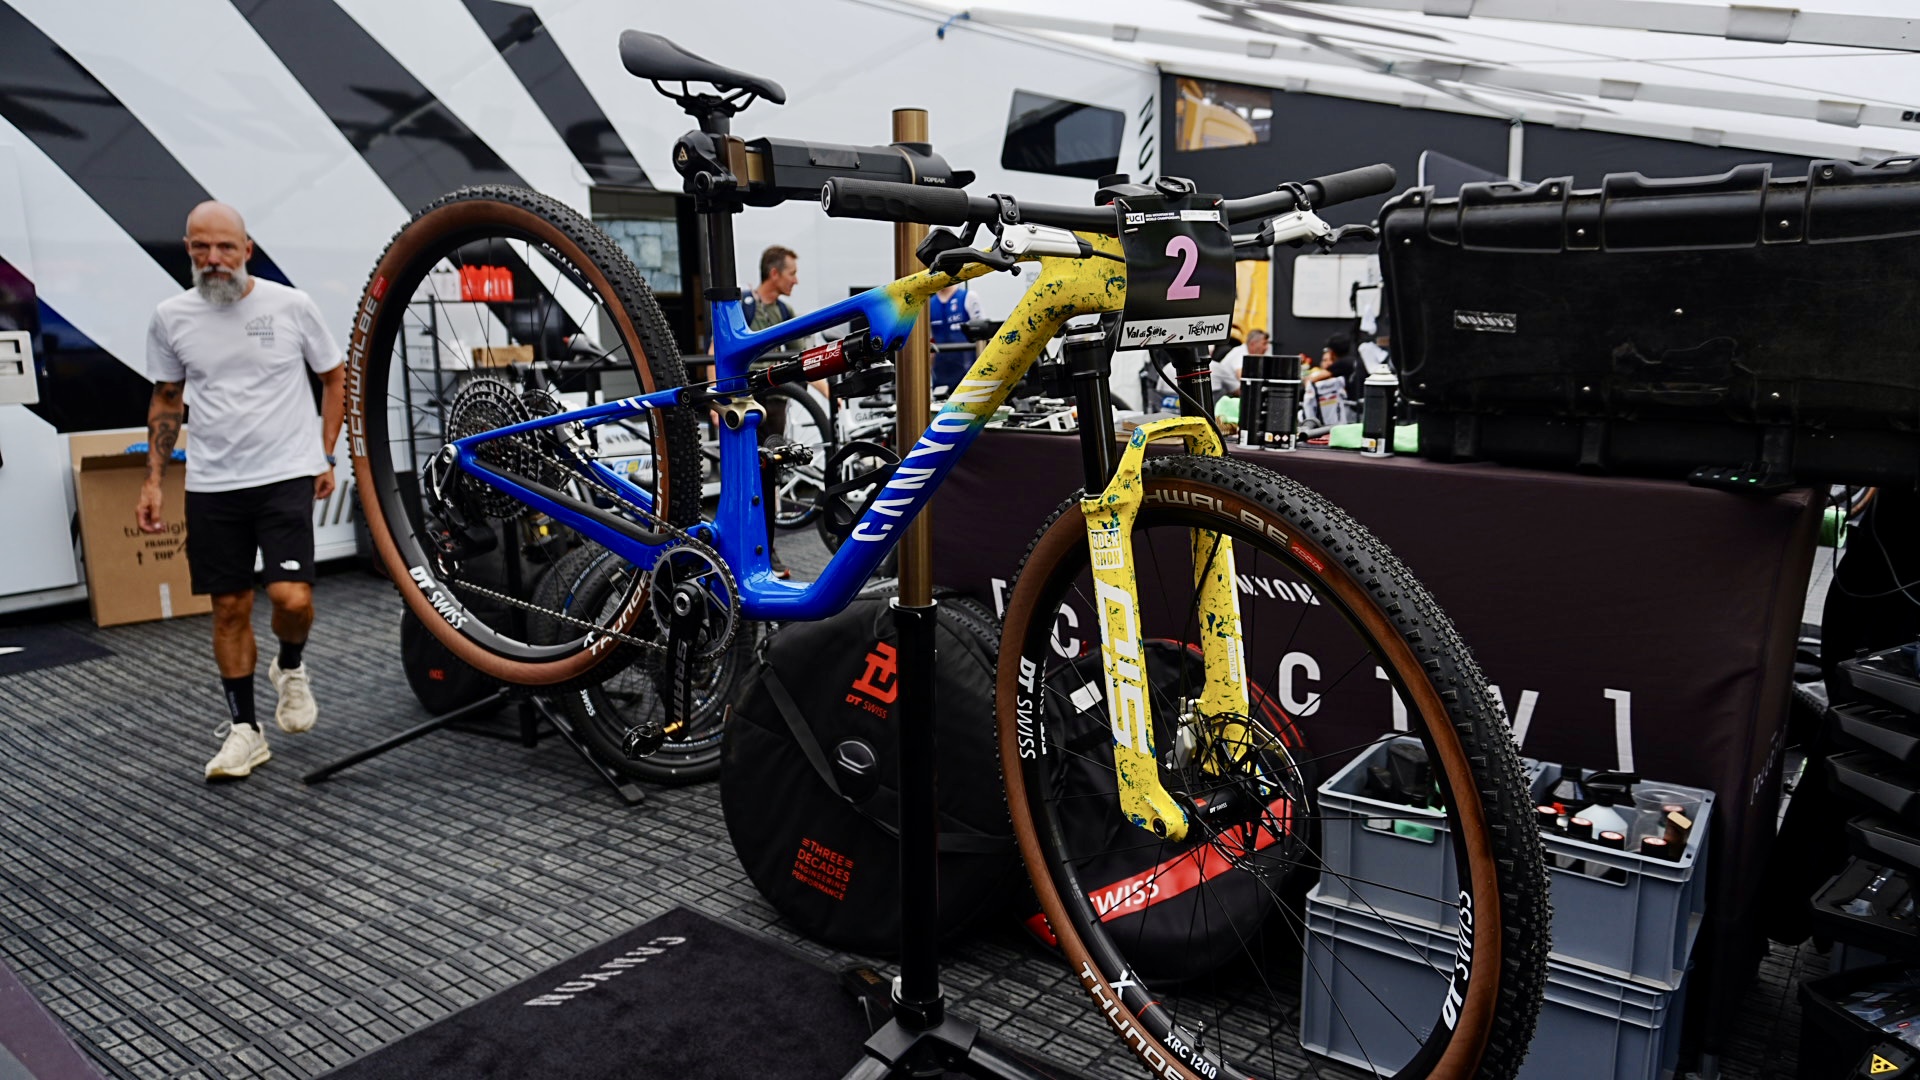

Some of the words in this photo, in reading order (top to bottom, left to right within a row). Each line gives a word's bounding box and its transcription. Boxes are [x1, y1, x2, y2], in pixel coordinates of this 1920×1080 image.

[922, 176, 946, 184] TOPEAK
[1129, 214, 1144, 223] UCI
[1165, 235, 1201, 301] 2
[1126, 326, 1140, 339] Val
[1187, 321, 1225, 336] TRENTINO
[350, 295, 379, 458] SCHWALBE
[851, 379, 1004, 542] CANYON
[1143, 488, 1289, 548] HWALBE
[153, 550, 174, 561] TOP
[1090, 530, 1120, 549] ROCK
[1094, 550, 1121, 567] SHOX
[408, 565, 437, 589] DT
[427, 590, 469, 630] SWISS
[1235, 573, 1321, 606] NYON
[589, 569, 650, 657] THUNDE
[673, 639, 688, 724] SRAM
[1018, 655, 1036, 694] DT
[579, 688, 597, 717] SWISS
[845, 693, 863, 706] DT
[862, 700, 888, 719] SWISS
[1016, 695, 1036, 760] SWISS
[797, 848, 851, 882] DECADES
[810, 840, 846, 867] THREE
[791, 869, 845, 901] PERFORMANCE
[794, 860, 848, 892] ENGINEERING
[1091, 873, 1160, 915] WISS
[523, 936, 687, 1006] CANYON
[1442, 973, 1463, 1031] DT
[1455, 890, 1473, 981] SWISS
[1163, 1031, 1190, 1059] XRC
[1189, 1053, 1217, 1080] 1200
